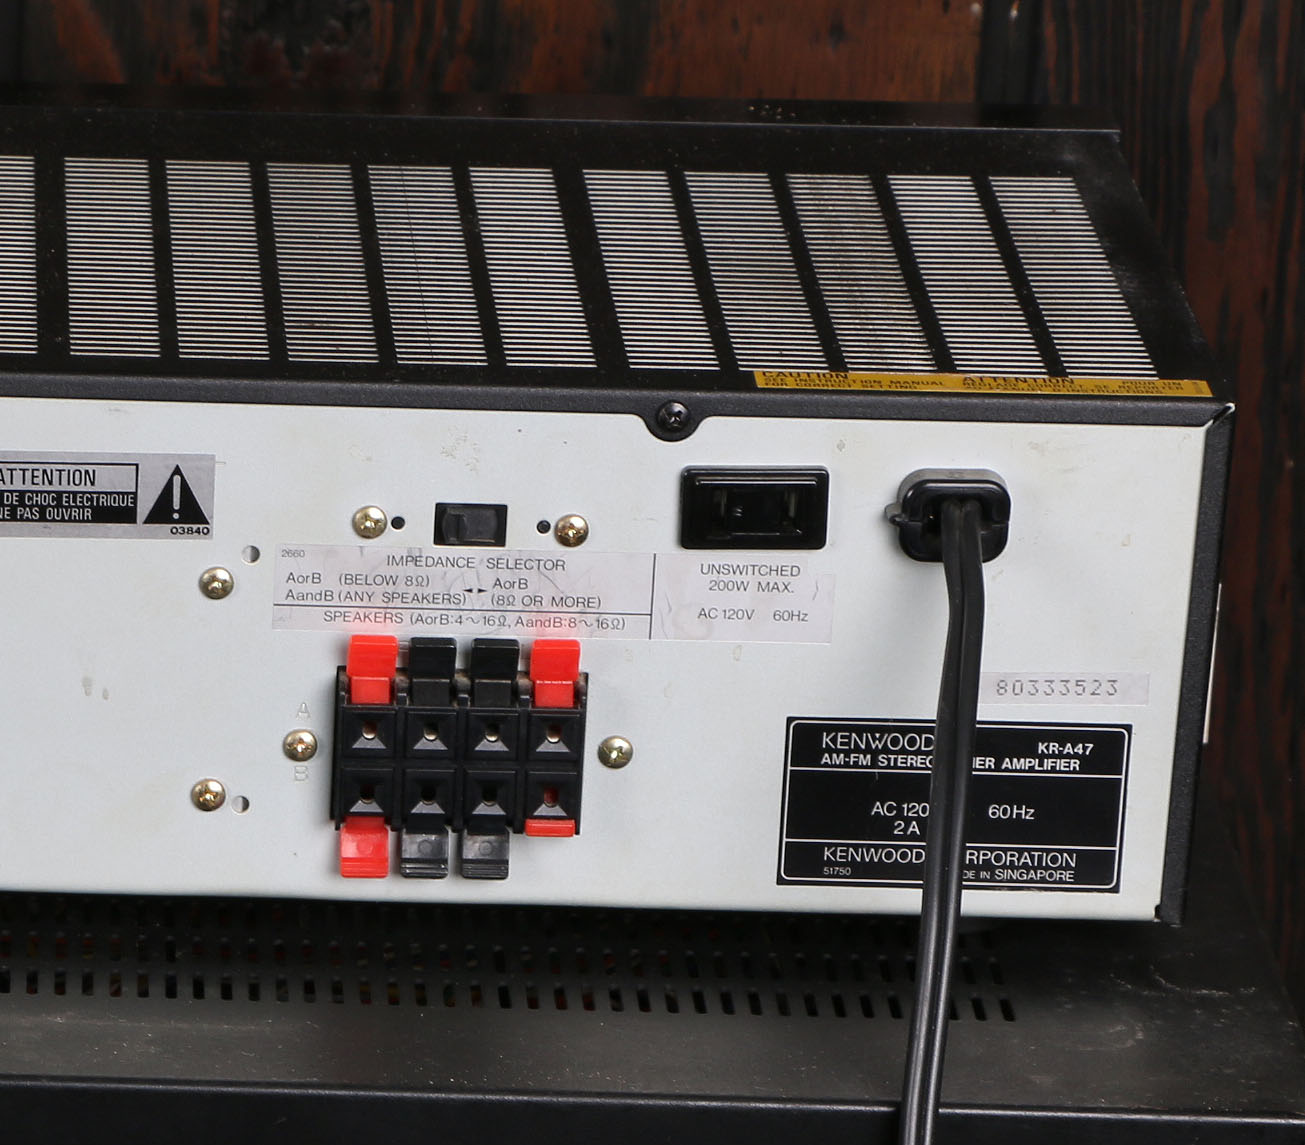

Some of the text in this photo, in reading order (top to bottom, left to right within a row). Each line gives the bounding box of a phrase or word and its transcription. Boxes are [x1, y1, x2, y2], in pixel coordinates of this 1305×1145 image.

[762, 371, 848, 380] CAUTION
[3, 493, 20, 506] DE
[24, 493, 58, 507] CHOC
[62, 494, 135, 509] ELECTRIQUE
[16, 507, 42, 520] PAS
[45, 507, 93, 521] OUVRIR
[170, 526, 210, 536] 03840
[281, 549, 305, 558] 2660
[387, 554, 566, 571] IMPEDANCE SELECTOR
[699, 563, 801, 578] UNSWITCHED
[286, 572, 322, 585] AorB
[338, 573, 399, 587] (BELOW
[492, 578, 529, 590] AorB
[708, 580, 795, 595] 200W MAX.
[285, 589, 467, 607] AandB (ANY SPEAKERS)
[521, 595, 544, 607] OR
[550, 596, 602, 609] MORE)
[323, 610, 404, 624] SPEAKERS
[697, 608, 808, 624] AC 120V 60Hz
[996, 678, 1120, 697] 80333523
[822, 732, 1094, 756] KENWOOD KR-A47
[820, 753, 872, 767] AM-FM
[1002, 757, 1081, 772] AMPLIFIER
[871, 801, 897, 817] AC
[901, 802, 931, 818] 120
[823, 846, 1077, 868] KENWOOD RPORATION
[823, 866, 852, 877] 51750
[979, 870, 991, 880] IN
[994, 868, 1076, 882] SINGAPORE
